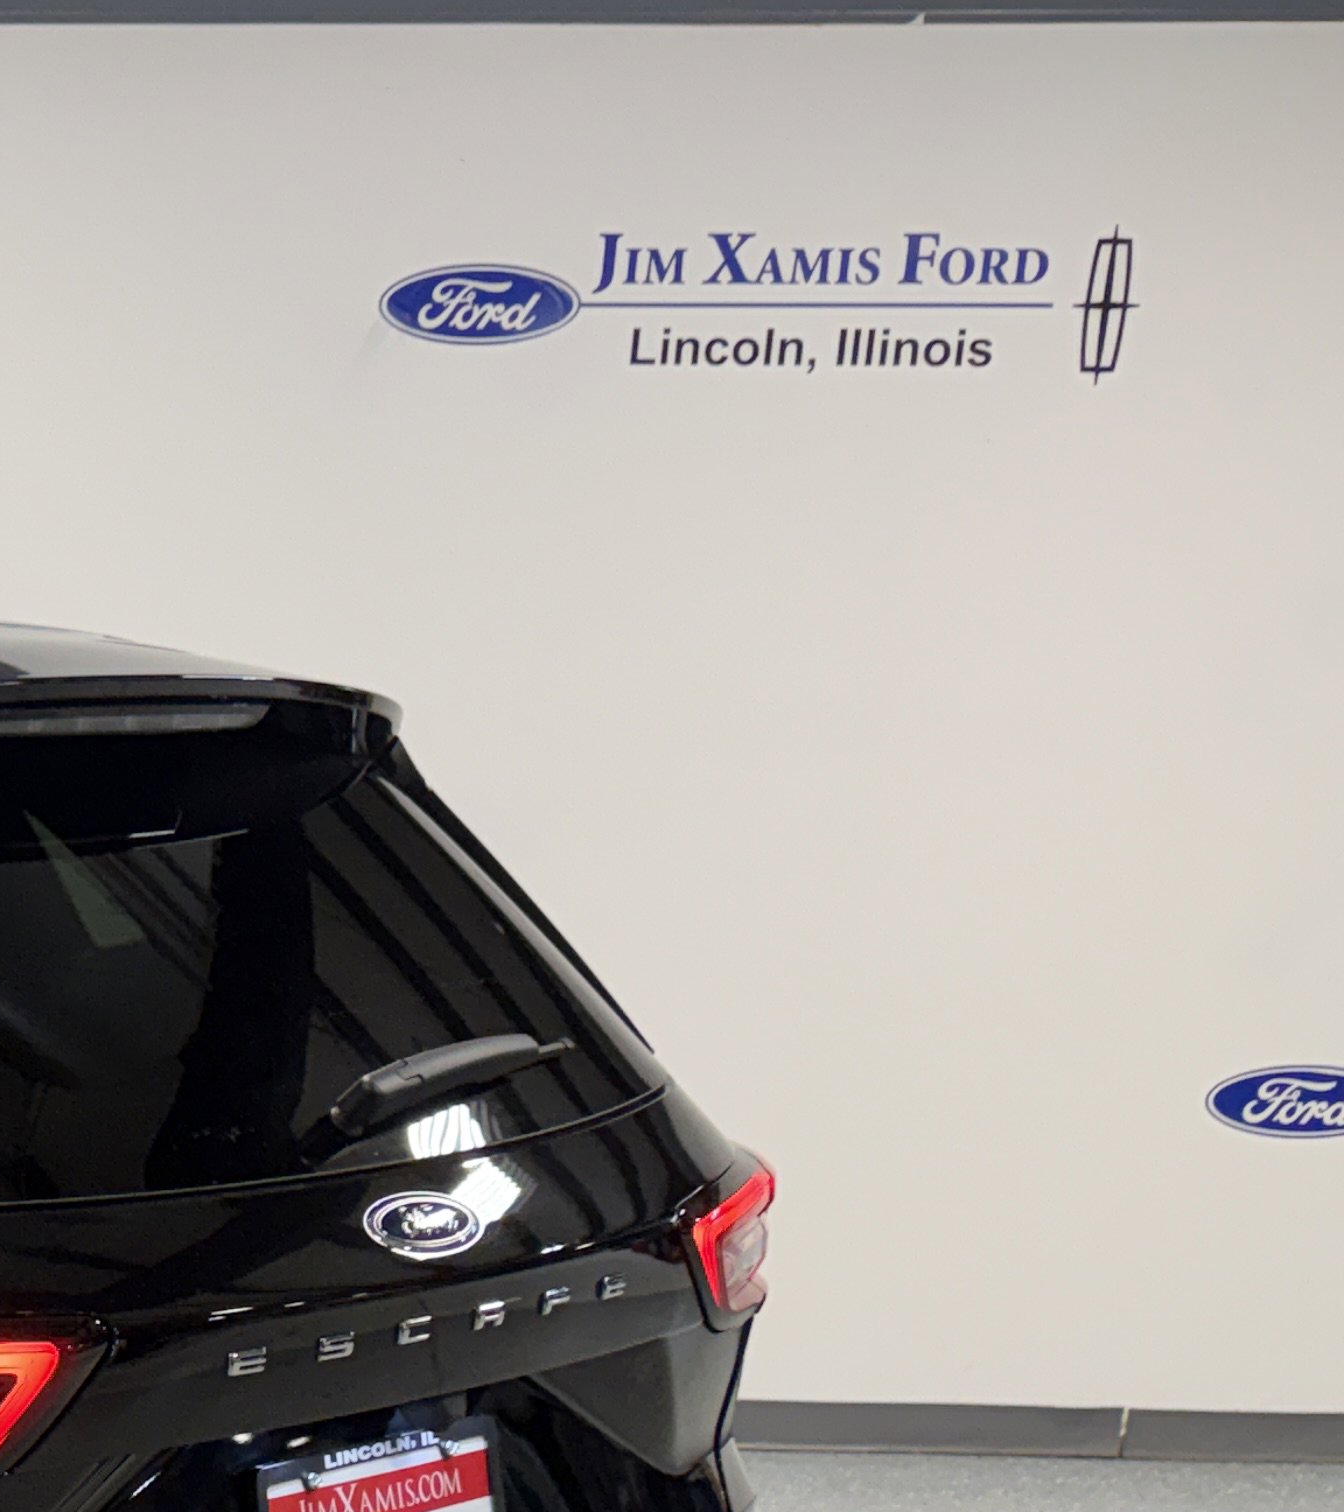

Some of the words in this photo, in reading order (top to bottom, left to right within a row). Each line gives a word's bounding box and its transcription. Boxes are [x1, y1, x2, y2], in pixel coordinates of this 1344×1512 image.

[592, 232, 687, 294] JIM
[702, 232, 881, 286] XAMIS
[899, 233, 1049, 286] FORD
[416, 277, 541, 332] Ford
[629, 328, 815, 374] Lincoln,
[835, 328, 993, 368] Illinois
[228, 1272, 627, 1377] ESCAPE
[324, 1436, 417, 1470] LINCOLN,
[420, 1430, 440, 1447] IL
